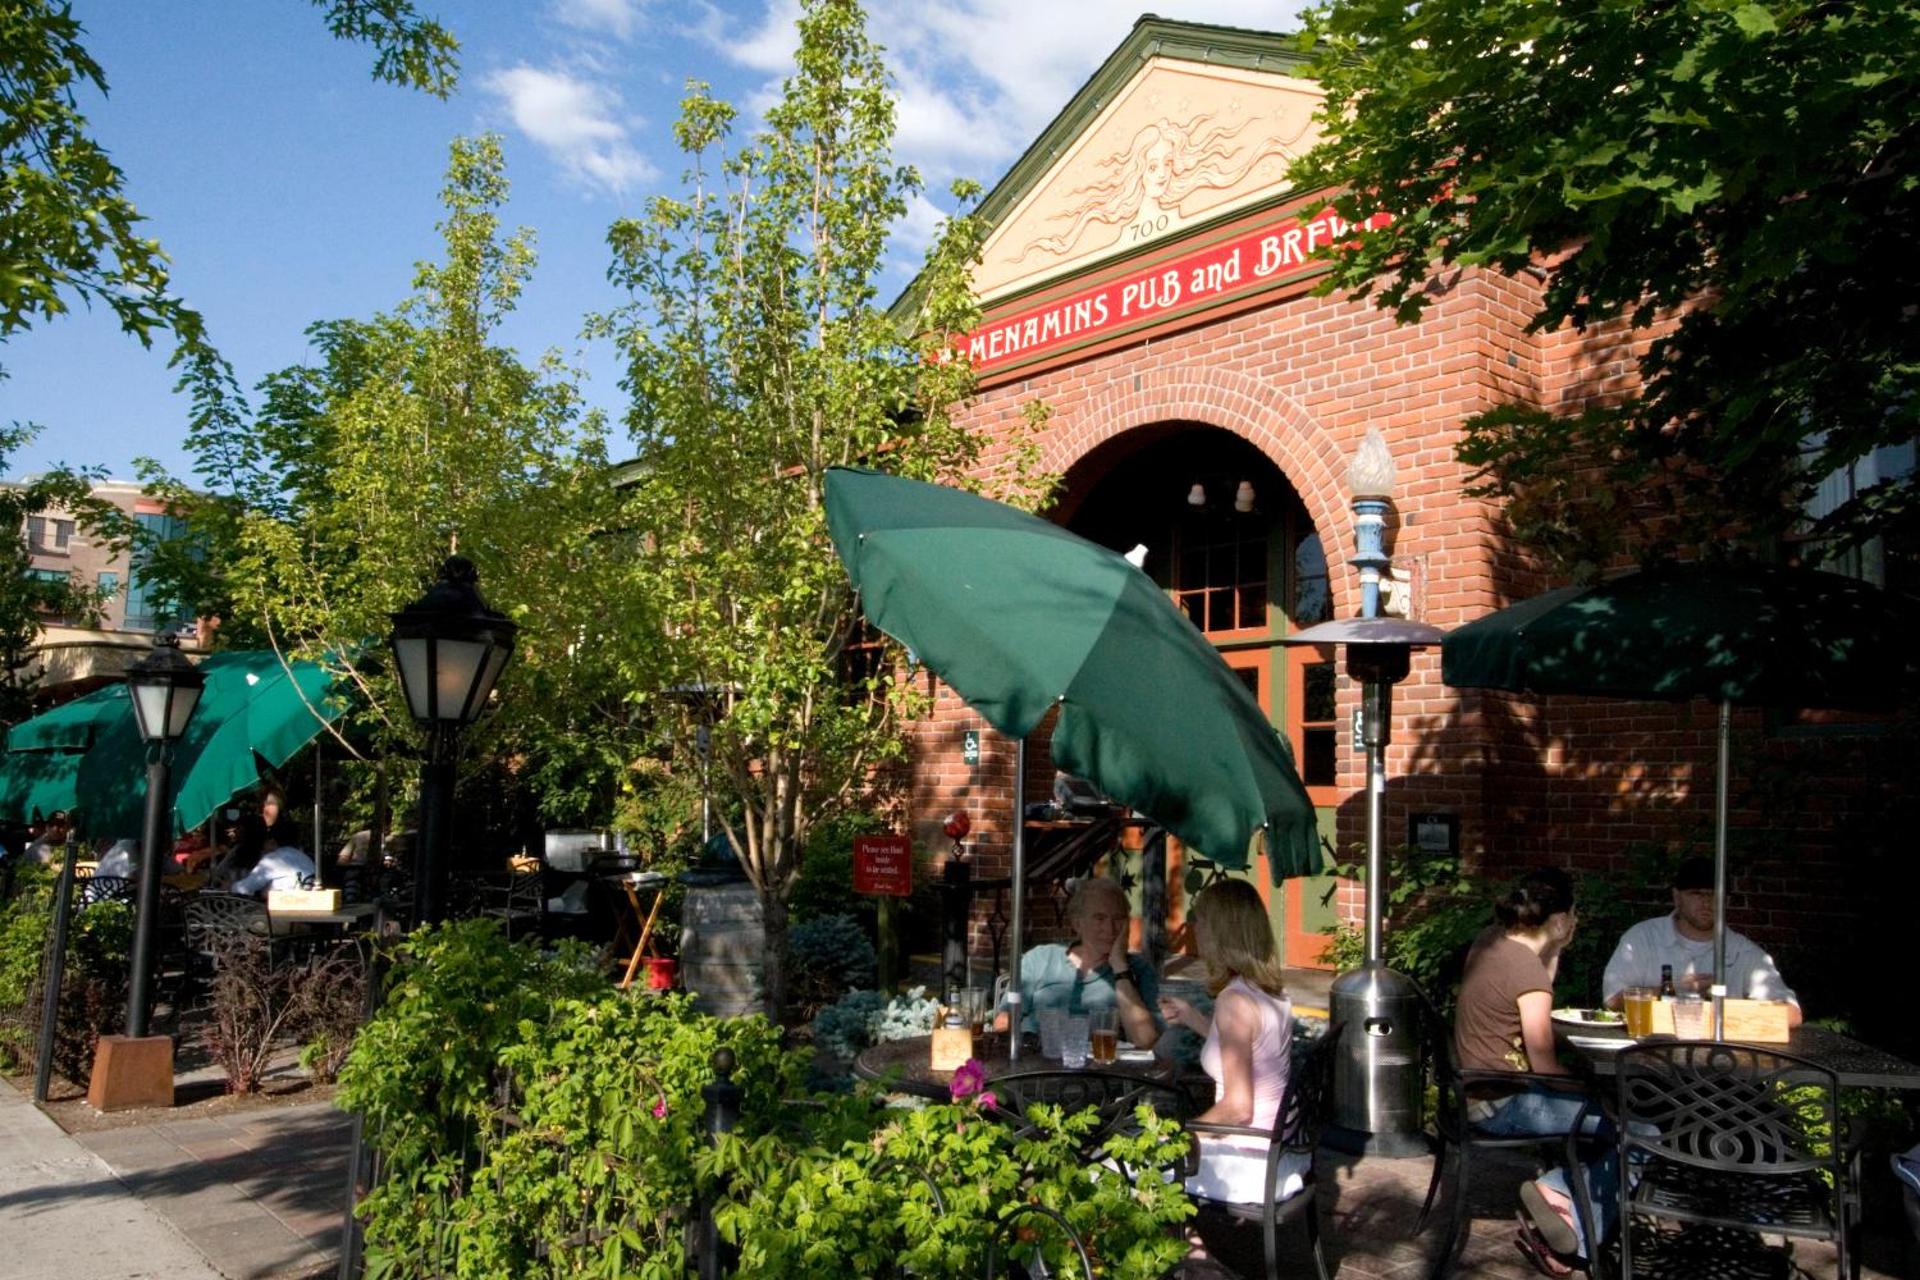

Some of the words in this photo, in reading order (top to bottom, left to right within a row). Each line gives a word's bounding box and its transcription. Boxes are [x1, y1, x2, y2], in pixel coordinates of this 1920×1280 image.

[1130, 214, 1169, 241] 700
[938, 294, 1108, 363] MENAMINS
[1121, 270, 1181, 317] PUB
[1190, 247, 1241, 293] and
